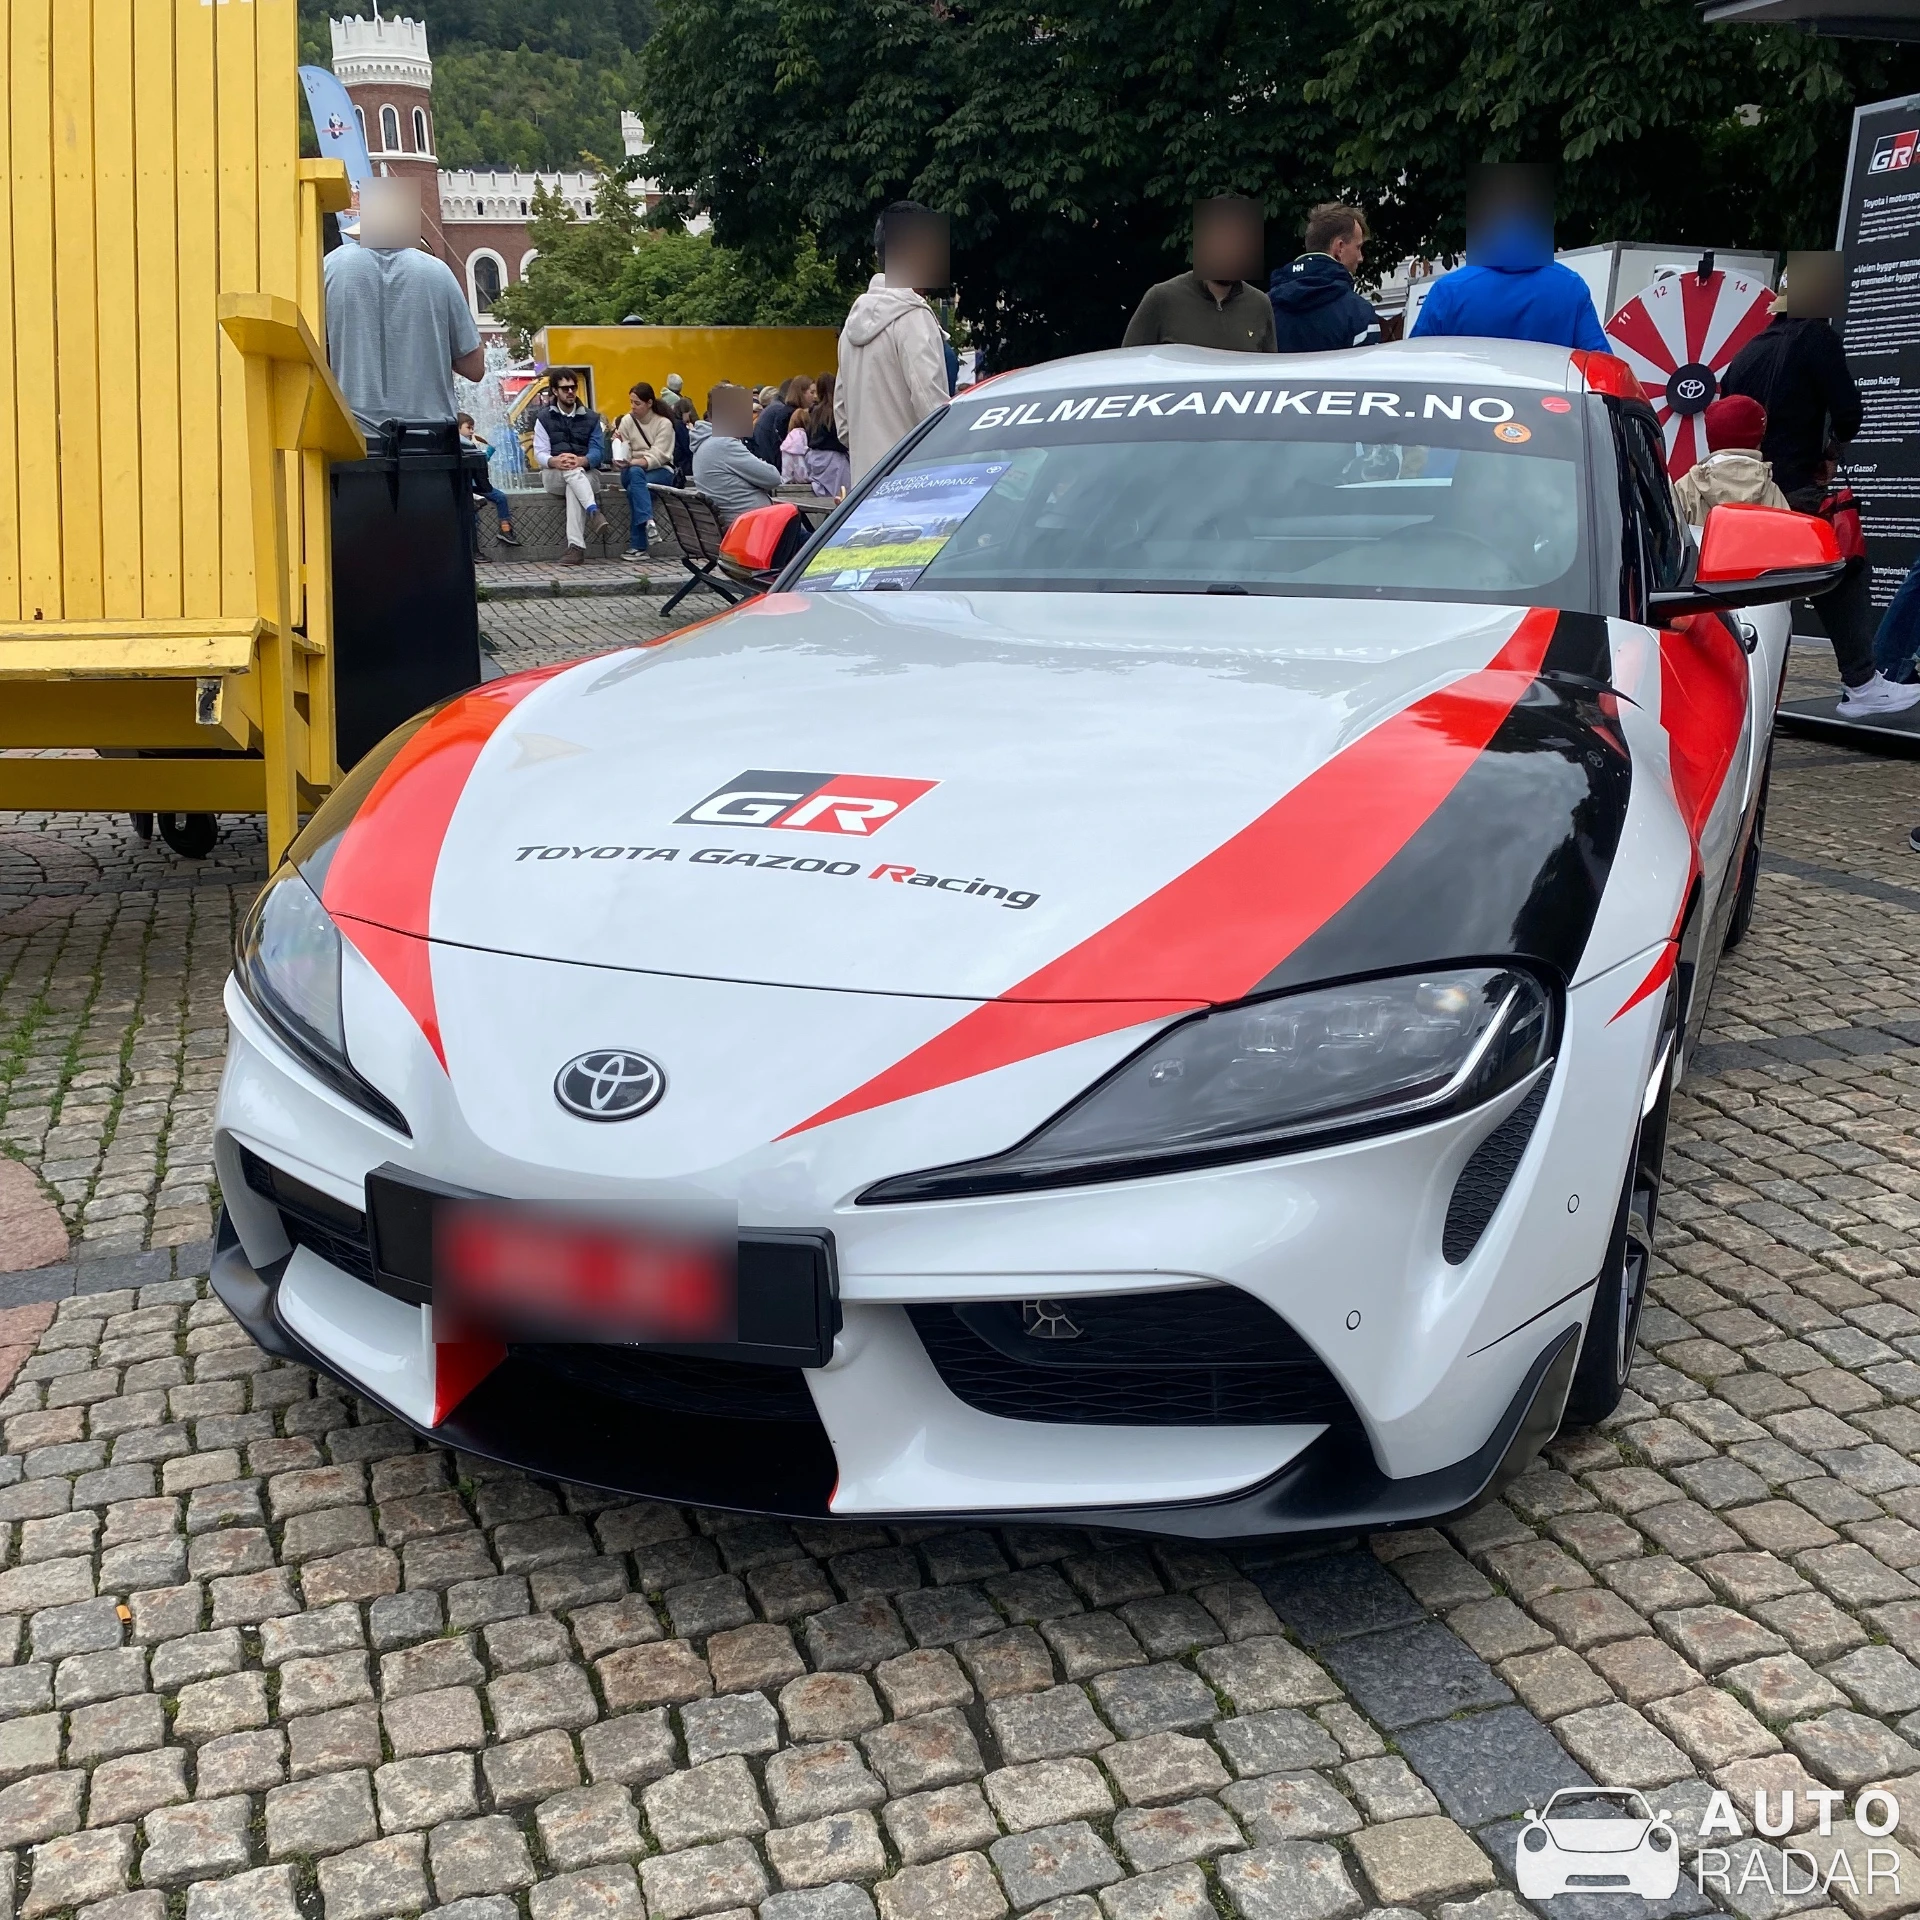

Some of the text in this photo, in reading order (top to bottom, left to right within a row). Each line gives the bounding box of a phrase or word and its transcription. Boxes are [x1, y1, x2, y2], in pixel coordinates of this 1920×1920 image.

[1872, 146, 1912, 171] GR
[1863, 198, 1885, 209] Toyota
[1876, 262, 1900, 272] bygger
[1734, 280, 1748, 293] 14
[1851, 273, 1919, 289] og mennesker bygger
[1653, 285, 1668, 299] 12
[1617, 311, 1632, 325] 11
[1858, 377, 1878, 387] Gazoo
[1878, 376, 1901, 387] Racing
[968, 390, 1515, 431] BILMEKANIKER.NO
[1853, 463, 1878, 473] Gazoo?
[873, 477, 978, 497] SOMMERKAMPANJE
[880, 474, 934, 489] ELEKTRISK
[689, 791, 899, 832] GR
[514, 845, 1041, 910] TOYOTA GAZOO Racing
